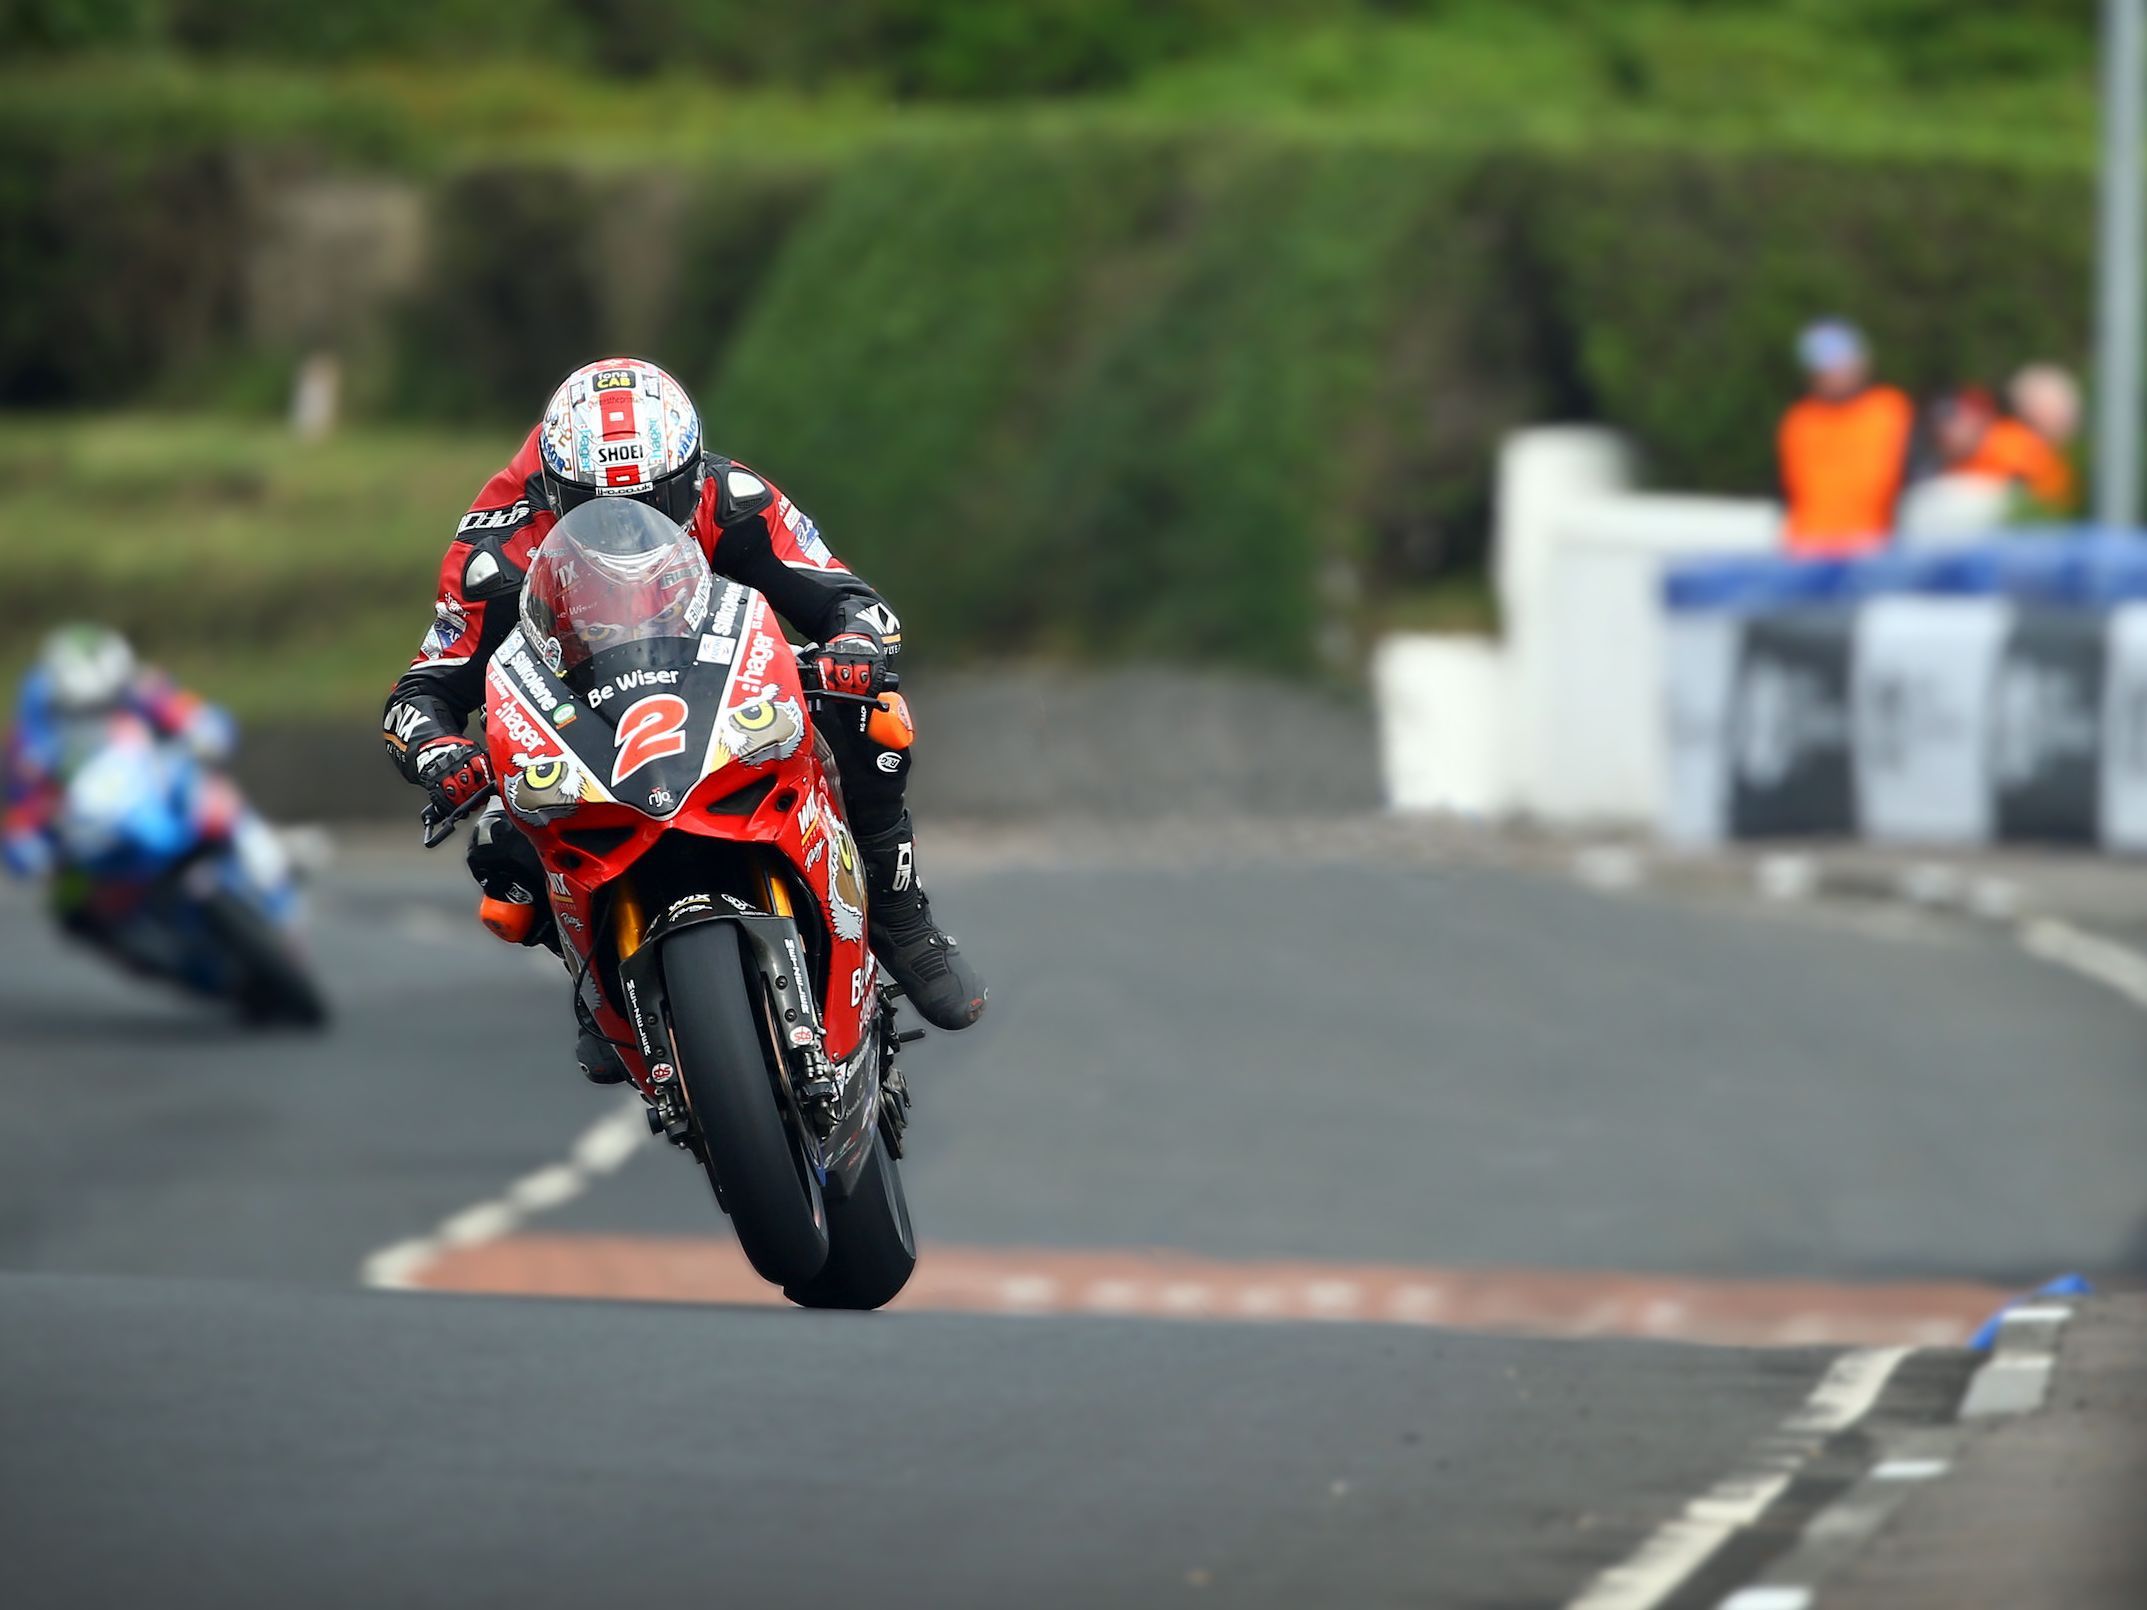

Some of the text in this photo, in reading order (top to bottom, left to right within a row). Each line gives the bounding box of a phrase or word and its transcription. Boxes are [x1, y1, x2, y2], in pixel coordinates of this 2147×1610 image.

[597, 378, 632, 389] CAB
[599, 445, 644, 463] SHOEI
[587, 668, 679, 708] Be Wiser
[610, 693, 689, 788] 2
[784, 938, 810, 1014] METZELER
[626, 979, 652, 1056] METZELER
